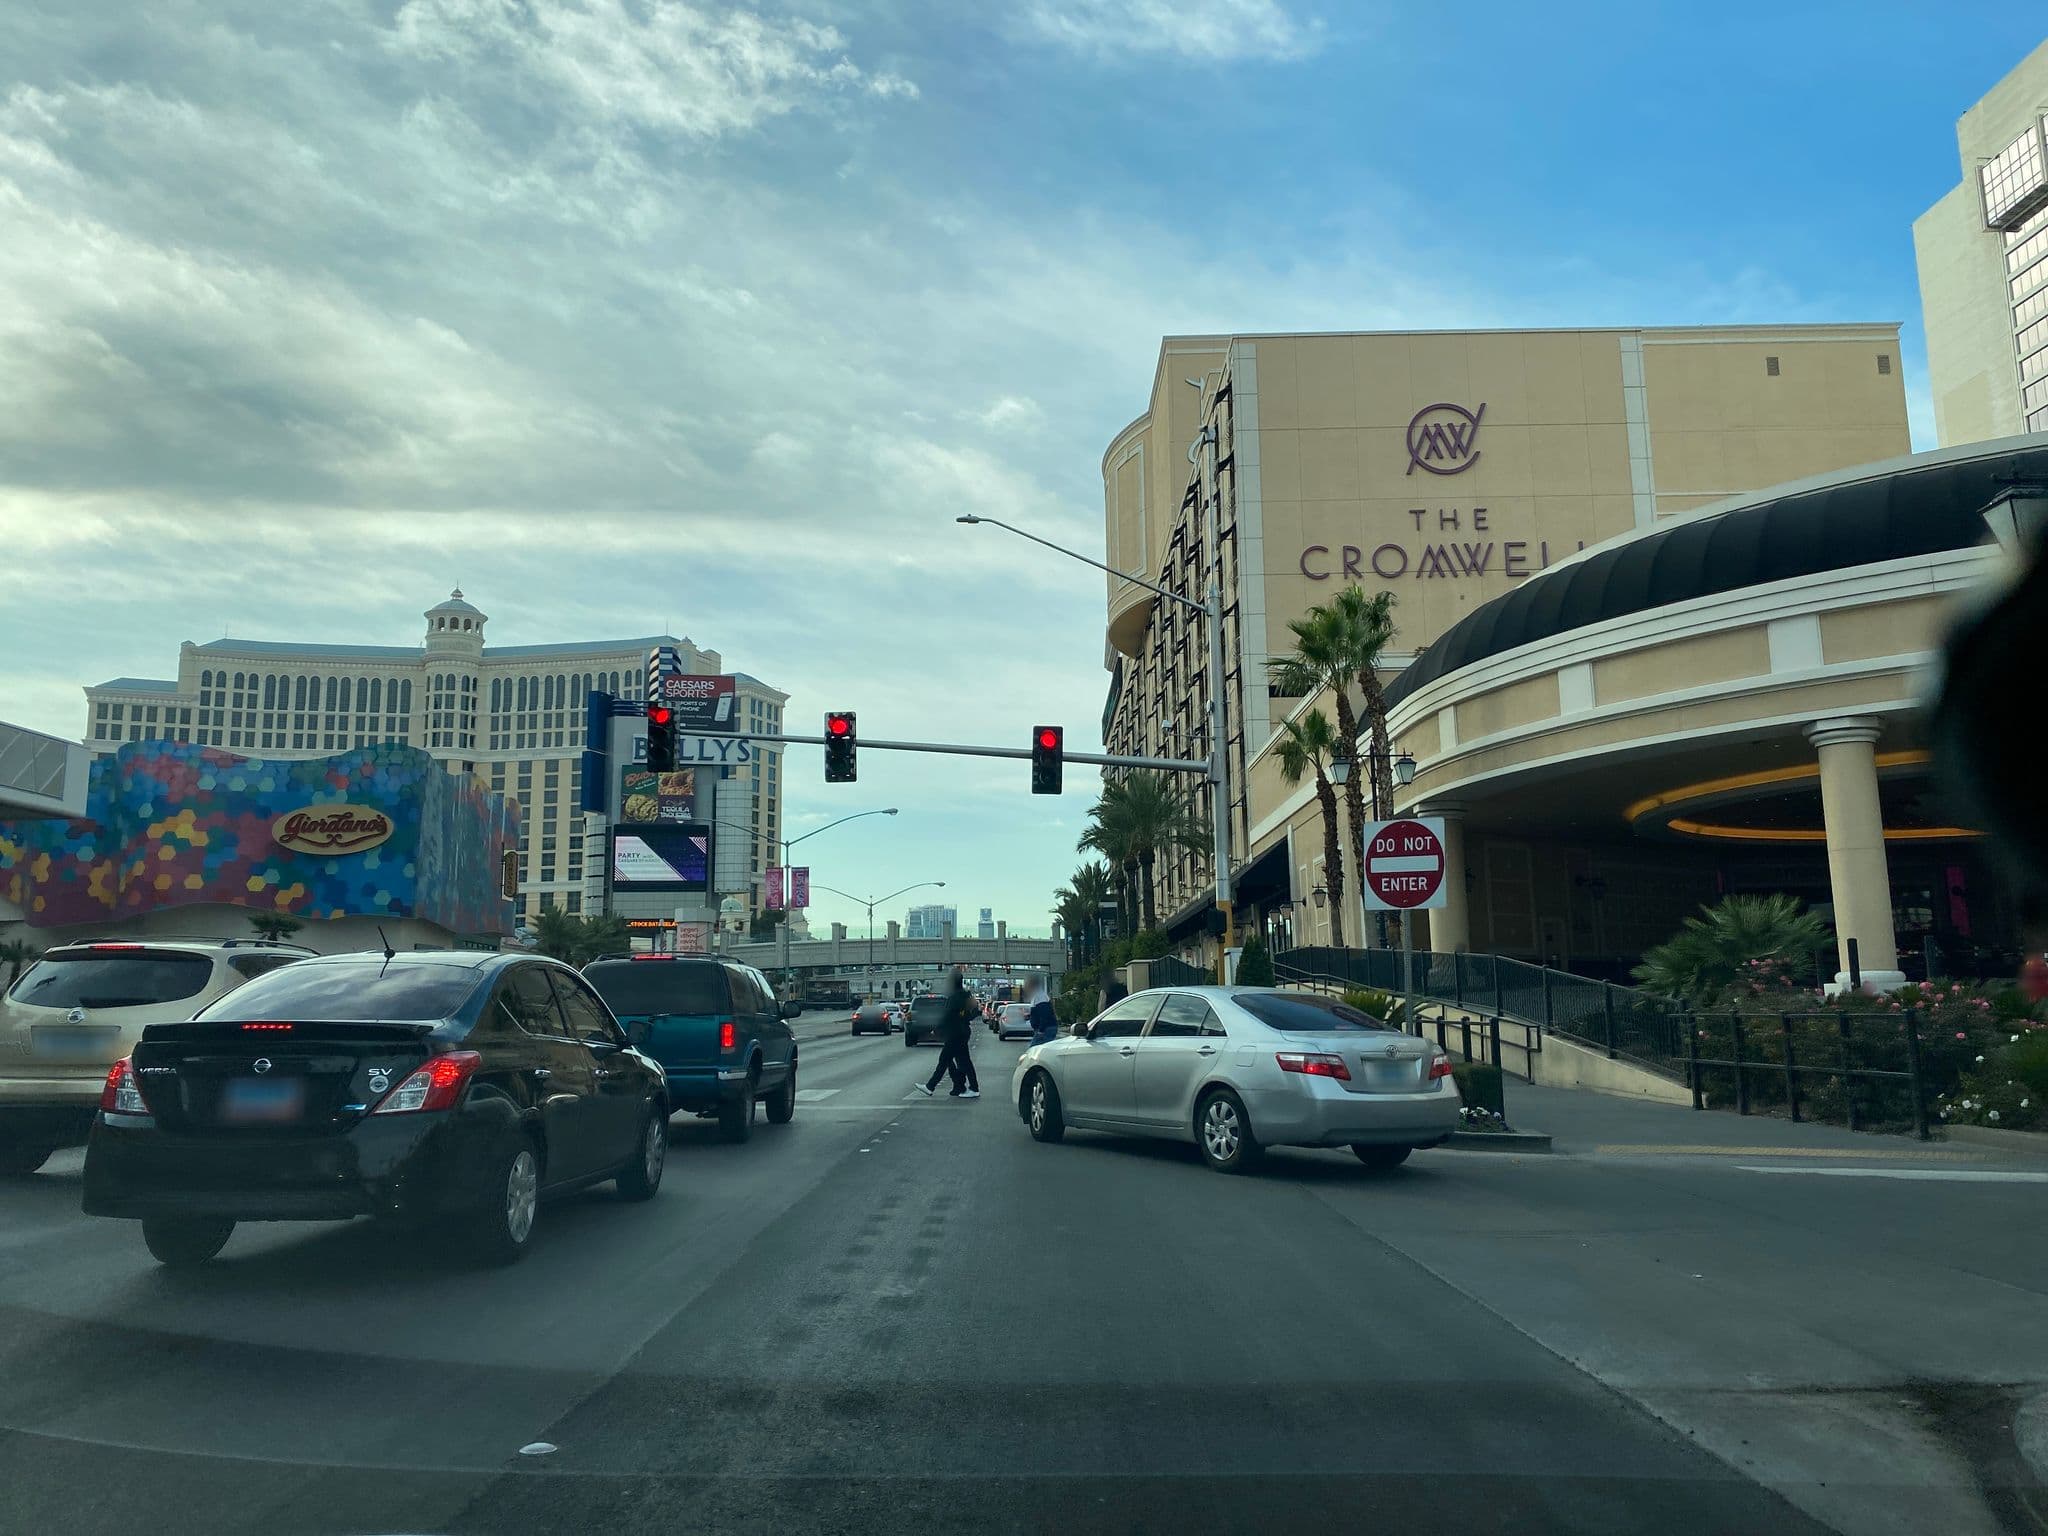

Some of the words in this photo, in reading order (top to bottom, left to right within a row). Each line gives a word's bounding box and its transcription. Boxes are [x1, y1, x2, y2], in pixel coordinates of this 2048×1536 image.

[1408, 507, 1489, 531] THE
[665, 680, 715, 690] CAESARS
[665, 690, 708, 698] SPORTS
[633, 738, 750, 761] BLLYS
[278, 811, 388, 843] Giordano's
[1376, 838, 1395, 853] DO
[1404, 836, 1433, 852] NOT
[1381, 876, 1428, 892] ENTER
[367, 1068, 393, 1076] SV
